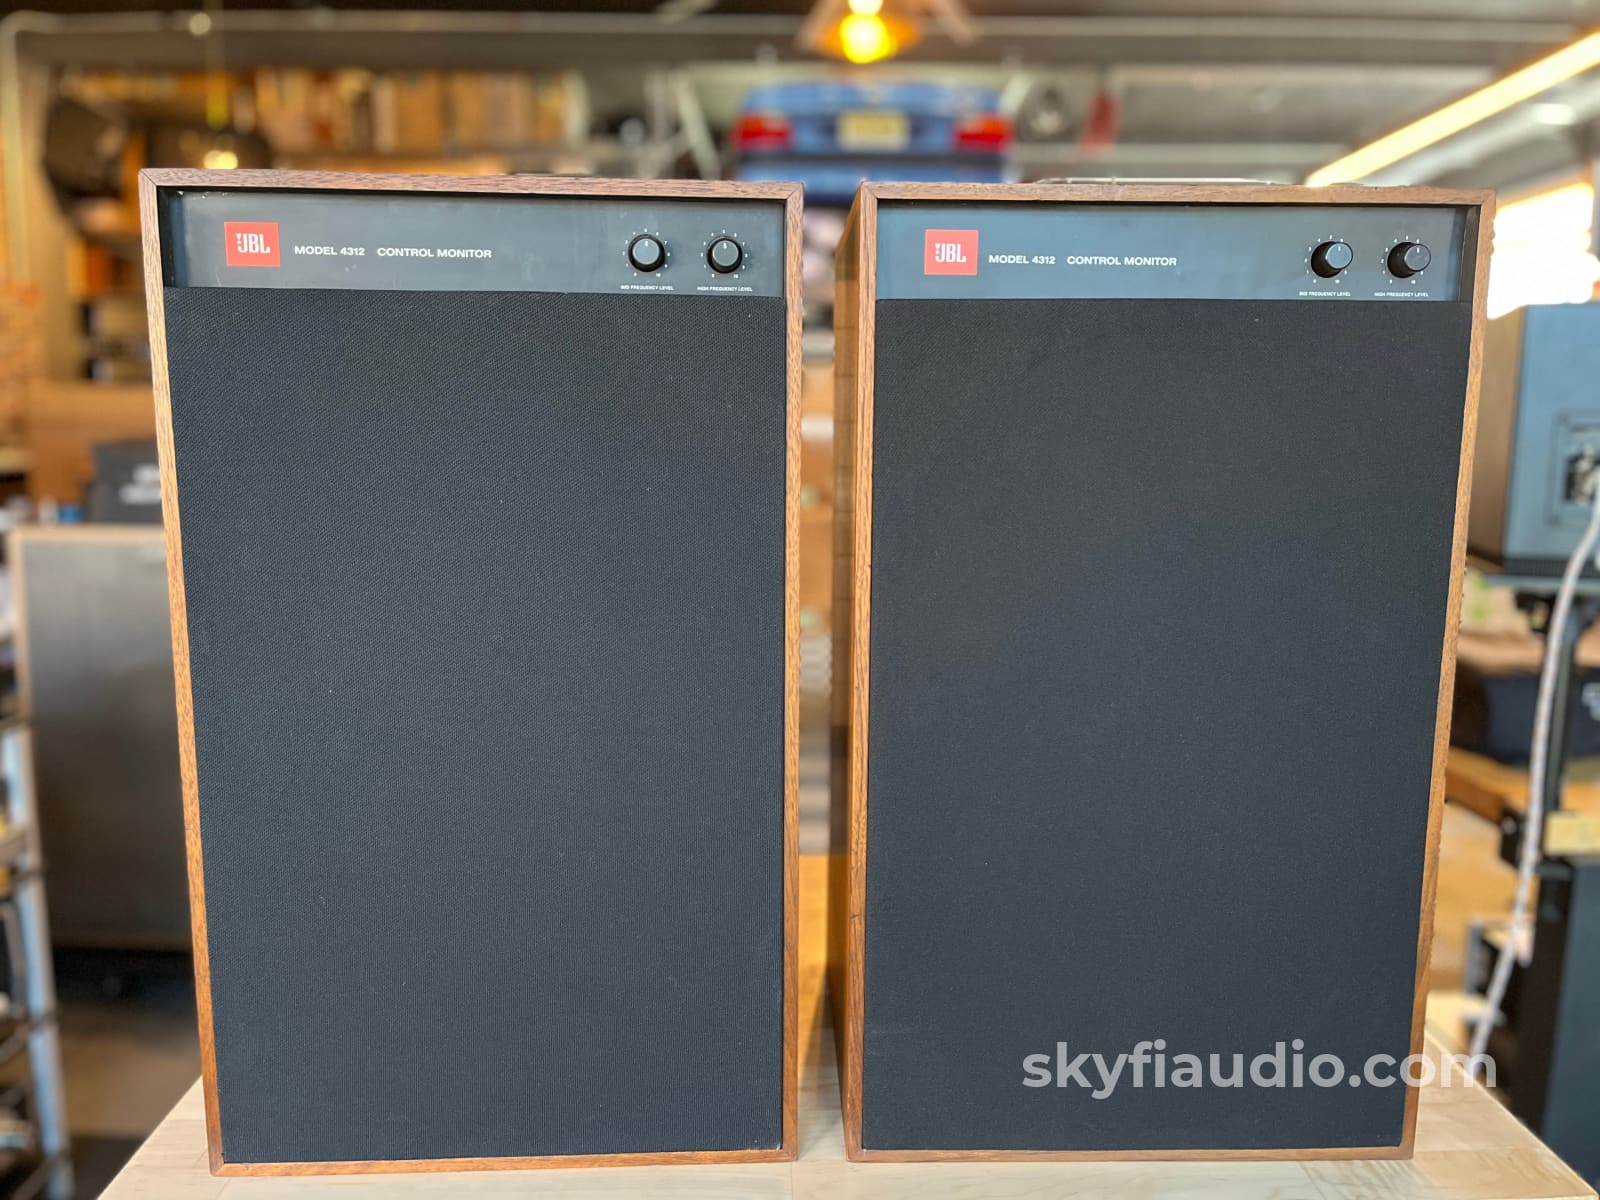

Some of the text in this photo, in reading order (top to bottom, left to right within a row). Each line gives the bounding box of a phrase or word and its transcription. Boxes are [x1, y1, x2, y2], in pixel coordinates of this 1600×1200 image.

[235, 232, 272, 254] JBL
[294, 245, 493, 260] MODEL 4312 CONTROL MONITOR
[934, 242, 967, 263] JBL
[988, 254, 1177, 267] MODEL 4312 CONTROL MONITOR
